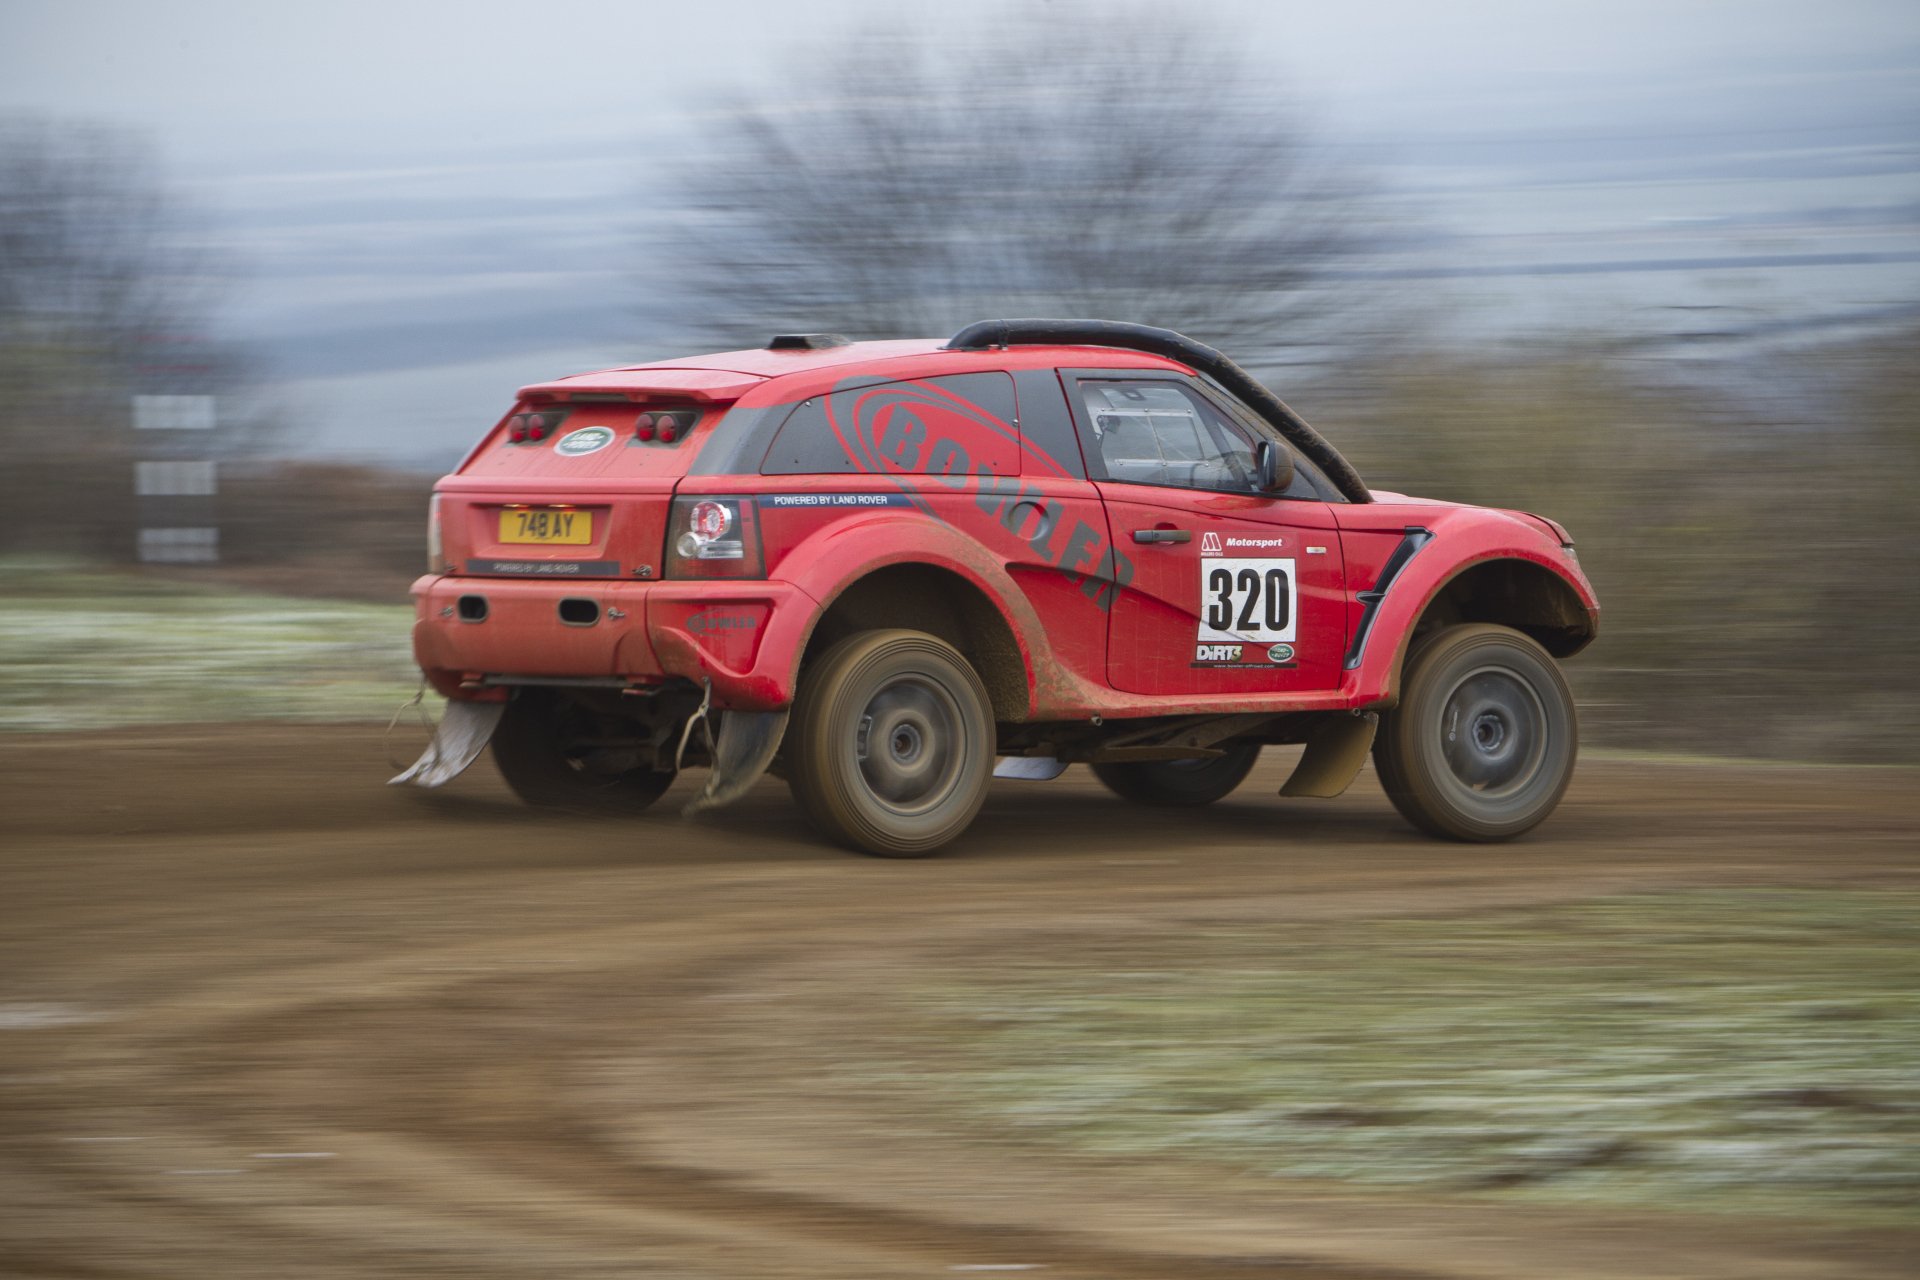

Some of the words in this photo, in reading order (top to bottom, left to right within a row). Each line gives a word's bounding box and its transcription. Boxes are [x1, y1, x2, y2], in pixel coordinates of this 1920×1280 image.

[774, 496, 818, 505] POWERED
[819, 496, 831, 504] BY
[832, 496, 857, 504] LAND
[858, 496, 888, 504] ROVER
[874, 402, 1135, 613] BOWLER
[517, 512, 549, 538] 748
[552, 513, 574, 537] AY
[1226, 538, 1283, 548] Motorsport
[1208, 568, 1290, 632] 320
